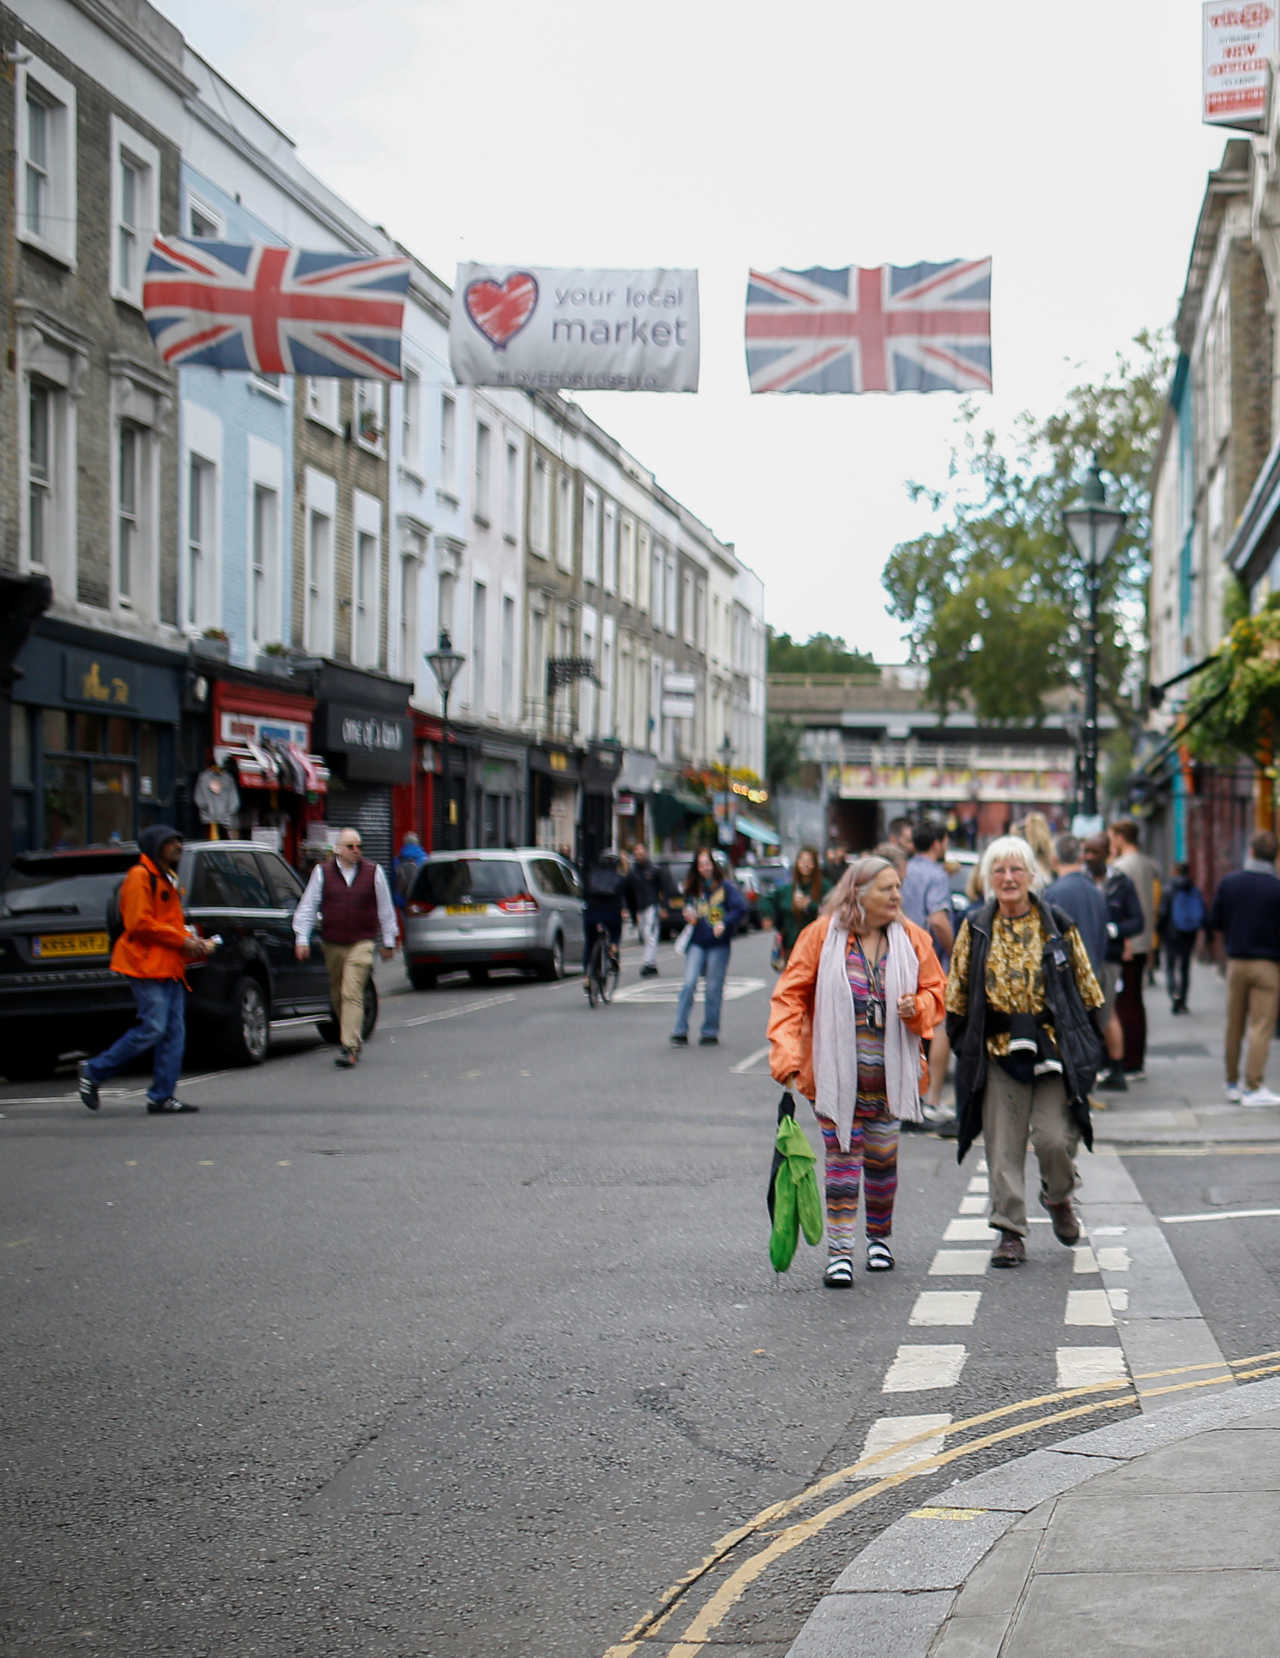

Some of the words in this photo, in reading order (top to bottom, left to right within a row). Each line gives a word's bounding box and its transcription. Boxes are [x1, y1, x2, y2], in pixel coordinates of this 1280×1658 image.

[554, 286, 615, 307] your
[626, 286, 683, 308] local
[552, 316, 688, 346] market
